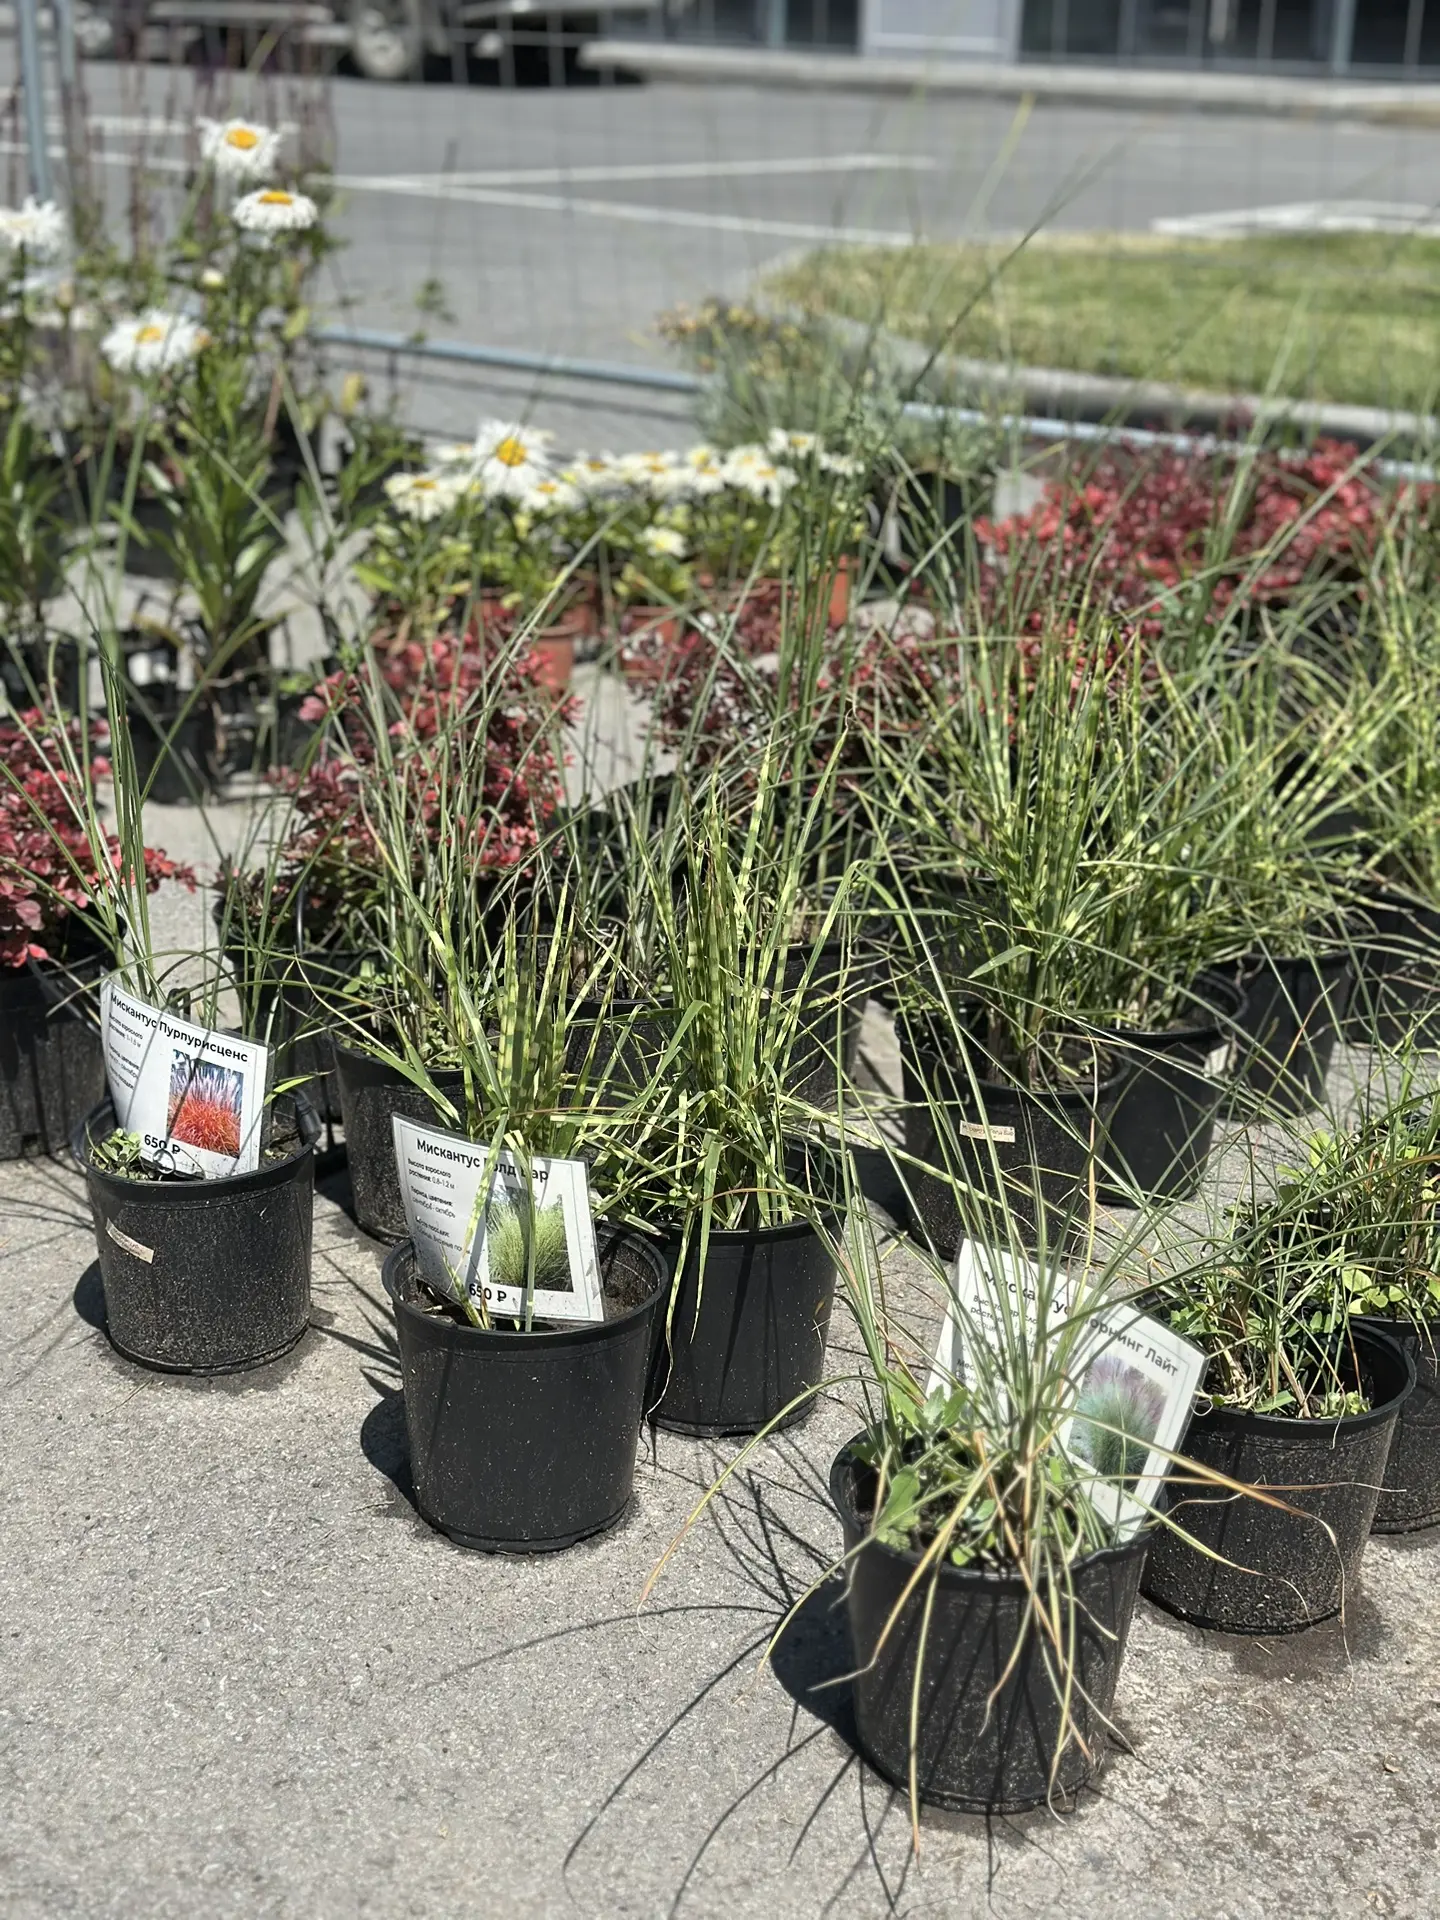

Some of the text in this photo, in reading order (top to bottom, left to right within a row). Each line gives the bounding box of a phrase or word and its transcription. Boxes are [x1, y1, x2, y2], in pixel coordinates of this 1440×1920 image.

[110, 992, 248, 1063] Мискантус Пурпурисценс
[144, 1134, 168, 1149] 650
[416, 1137, 481, 1169] Мискантус
[469, 1283, 492, 1300] 650
[1086, 1317, 1144, 1353] орнинг
[1145, 1347, 1178, 1377] Лайт
